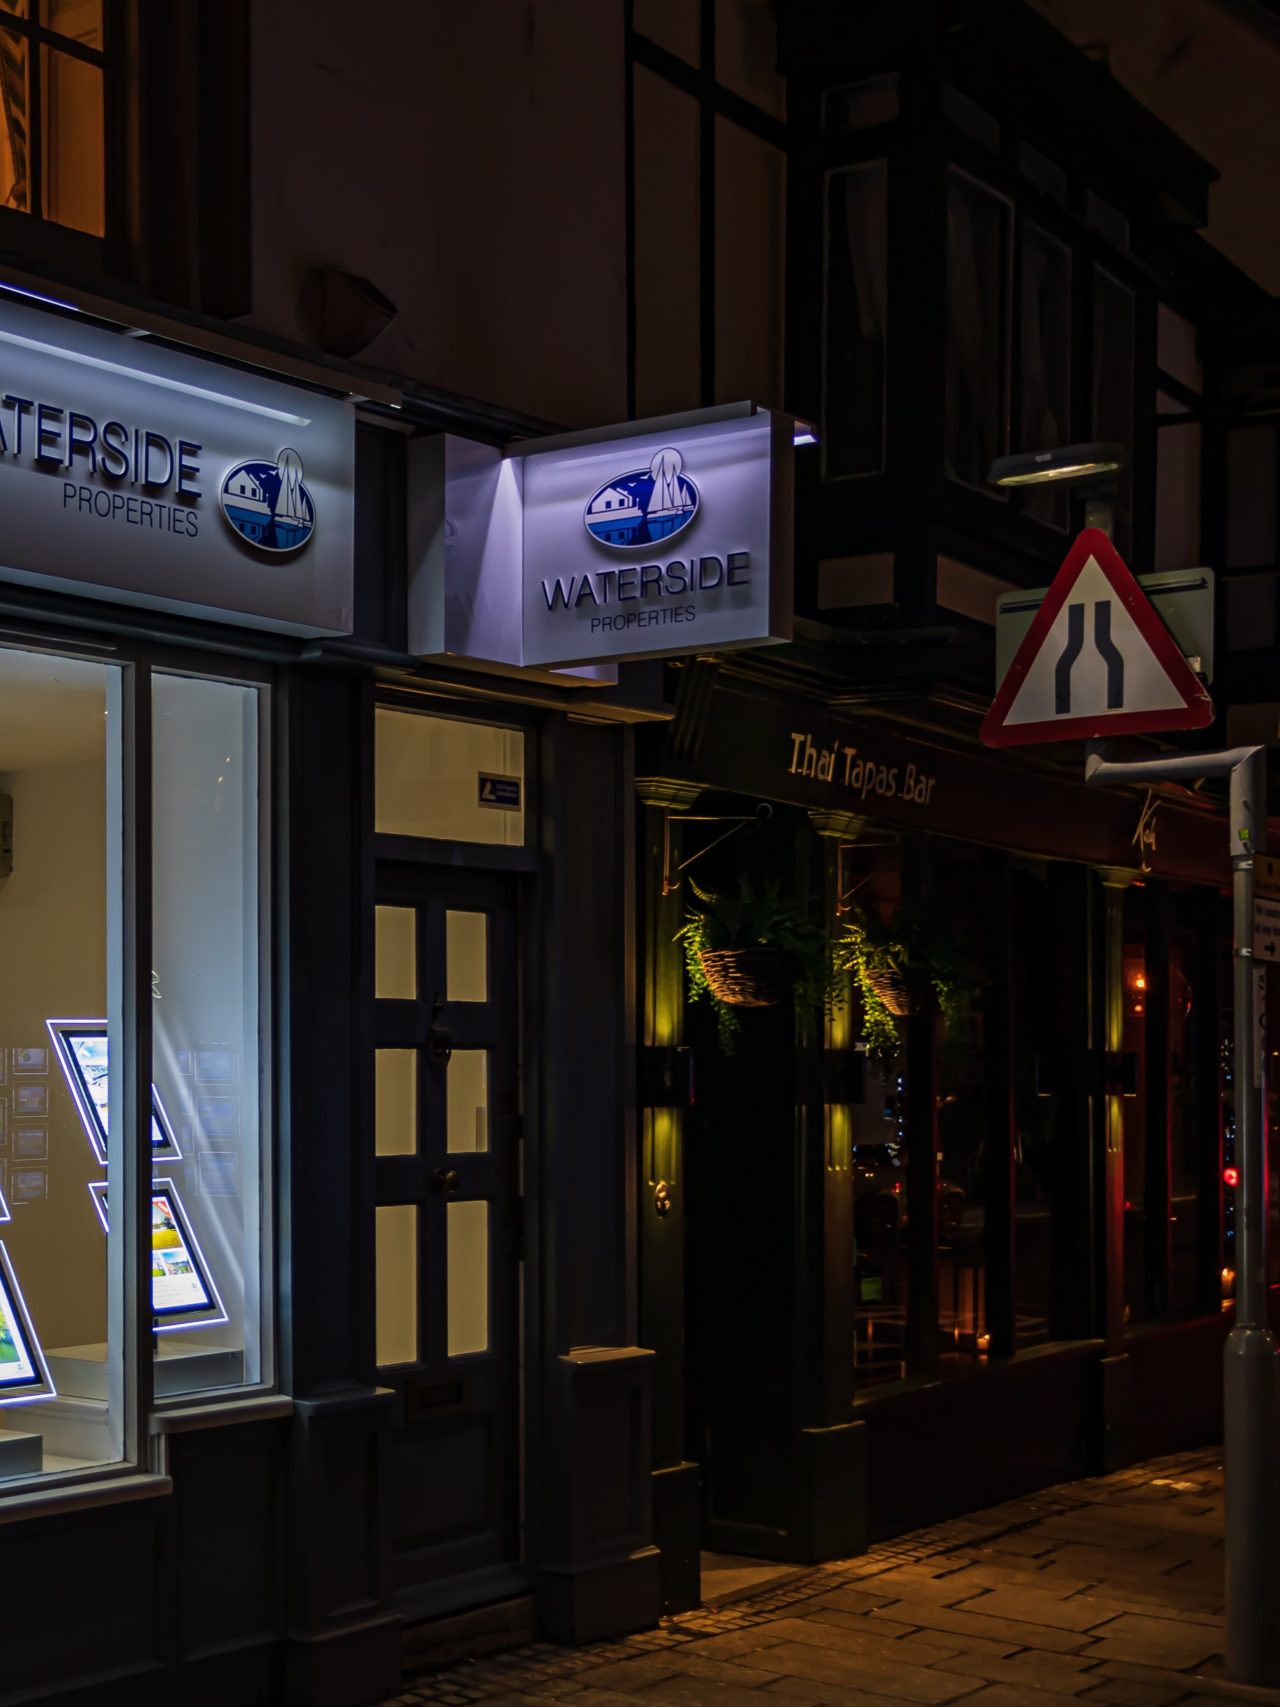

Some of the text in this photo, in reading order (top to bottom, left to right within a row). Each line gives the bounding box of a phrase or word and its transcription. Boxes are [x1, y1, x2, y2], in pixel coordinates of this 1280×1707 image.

[63, 482, 199, 538] PROPERTIES
[541, 550, 751, 612] WATERSIDE
[590, 605, 696, 634] PROPERTIES
[790, 732, 936, 804] Thai Tapas Bar
